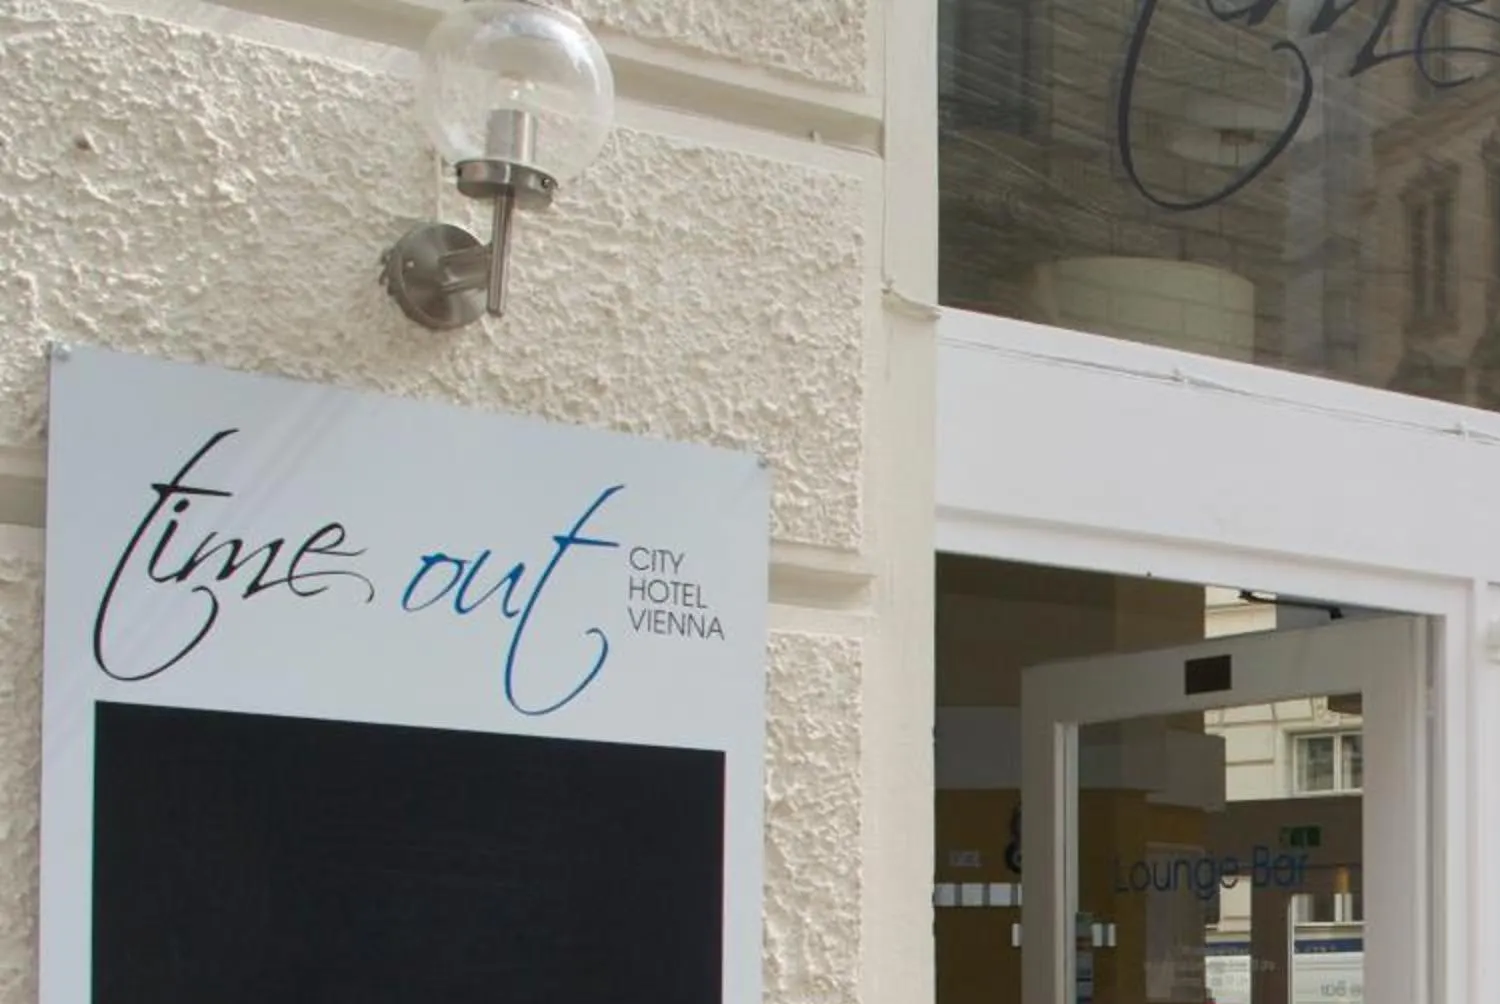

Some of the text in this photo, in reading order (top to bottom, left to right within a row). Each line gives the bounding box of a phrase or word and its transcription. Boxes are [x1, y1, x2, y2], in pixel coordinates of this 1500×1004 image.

[93, 427, 626, 715] time out
[629, 546, 686, 574] CITY
[629, 575, 708, 609] HOTEL
[627, 605, 725, 641] VIENNA
[1113, 845, 1309, 900] Lounge Bar
